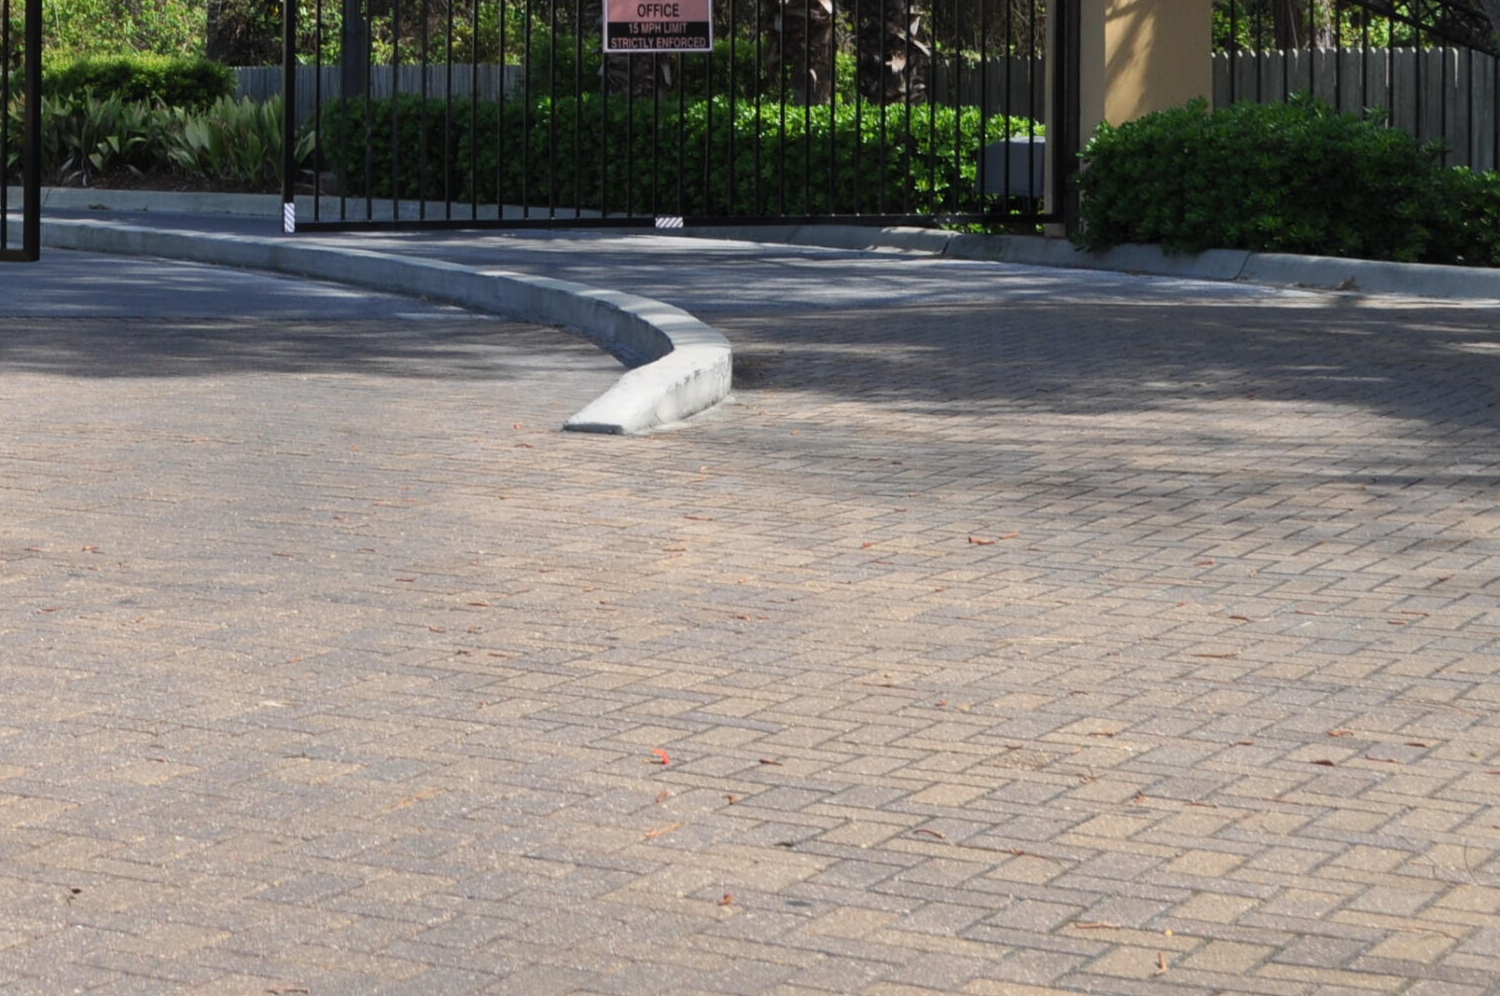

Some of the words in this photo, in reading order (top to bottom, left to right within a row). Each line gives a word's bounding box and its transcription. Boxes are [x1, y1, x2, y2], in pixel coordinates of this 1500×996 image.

[637, 4, 680, 17] OFFICE
[629, 23, 639, 34] 15
[641, 23, 661, 34] MPH
[664, 23, 687, 34] LIMIT
[611, 37, 654, 48] STRICTLY
[656, 37, 706, 48] ENFORCED
